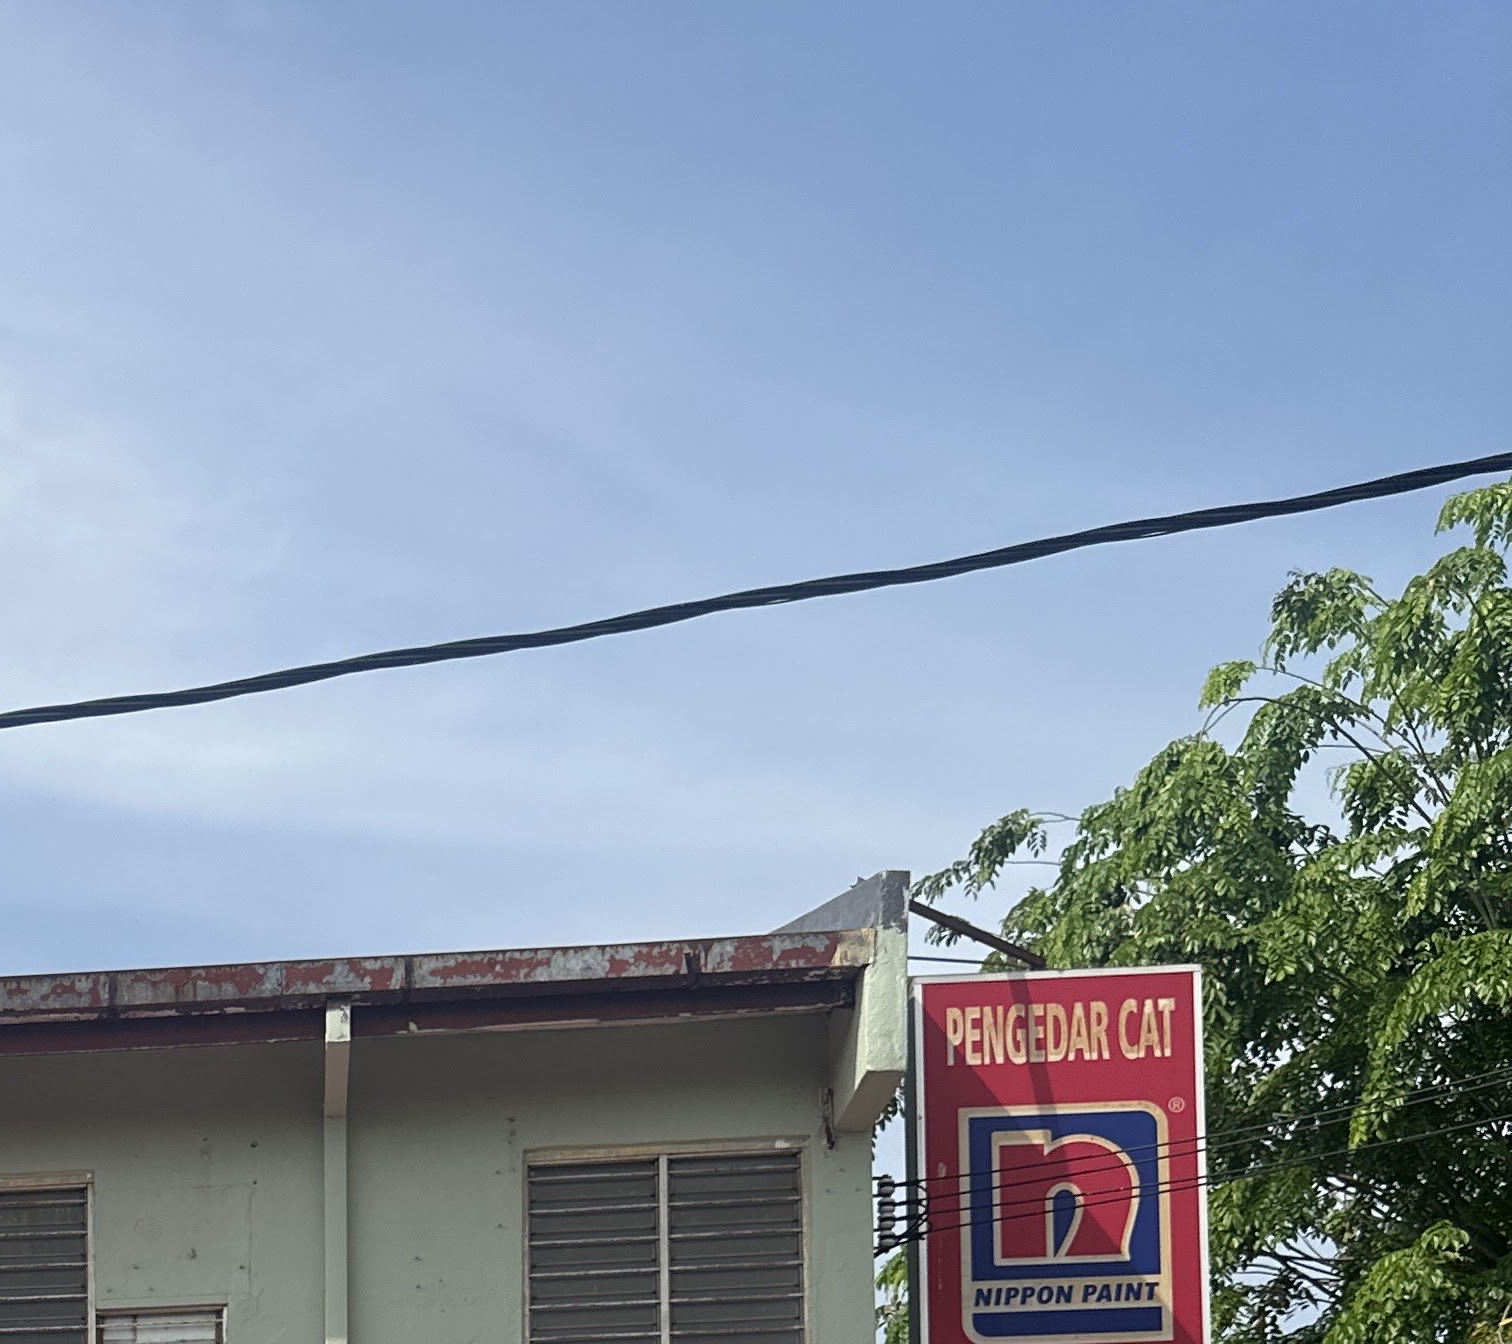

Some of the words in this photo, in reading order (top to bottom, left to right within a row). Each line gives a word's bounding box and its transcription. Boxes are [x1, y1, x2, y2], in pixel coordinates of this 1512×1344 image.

[945, 1000, 1111, 1067] PENGEDAR
[1117, 997, 1176, 1061] CAT
[973, 1284, 1074, 1307] NIPPON
[1081, 1282, 1160, 1303] PAINT
